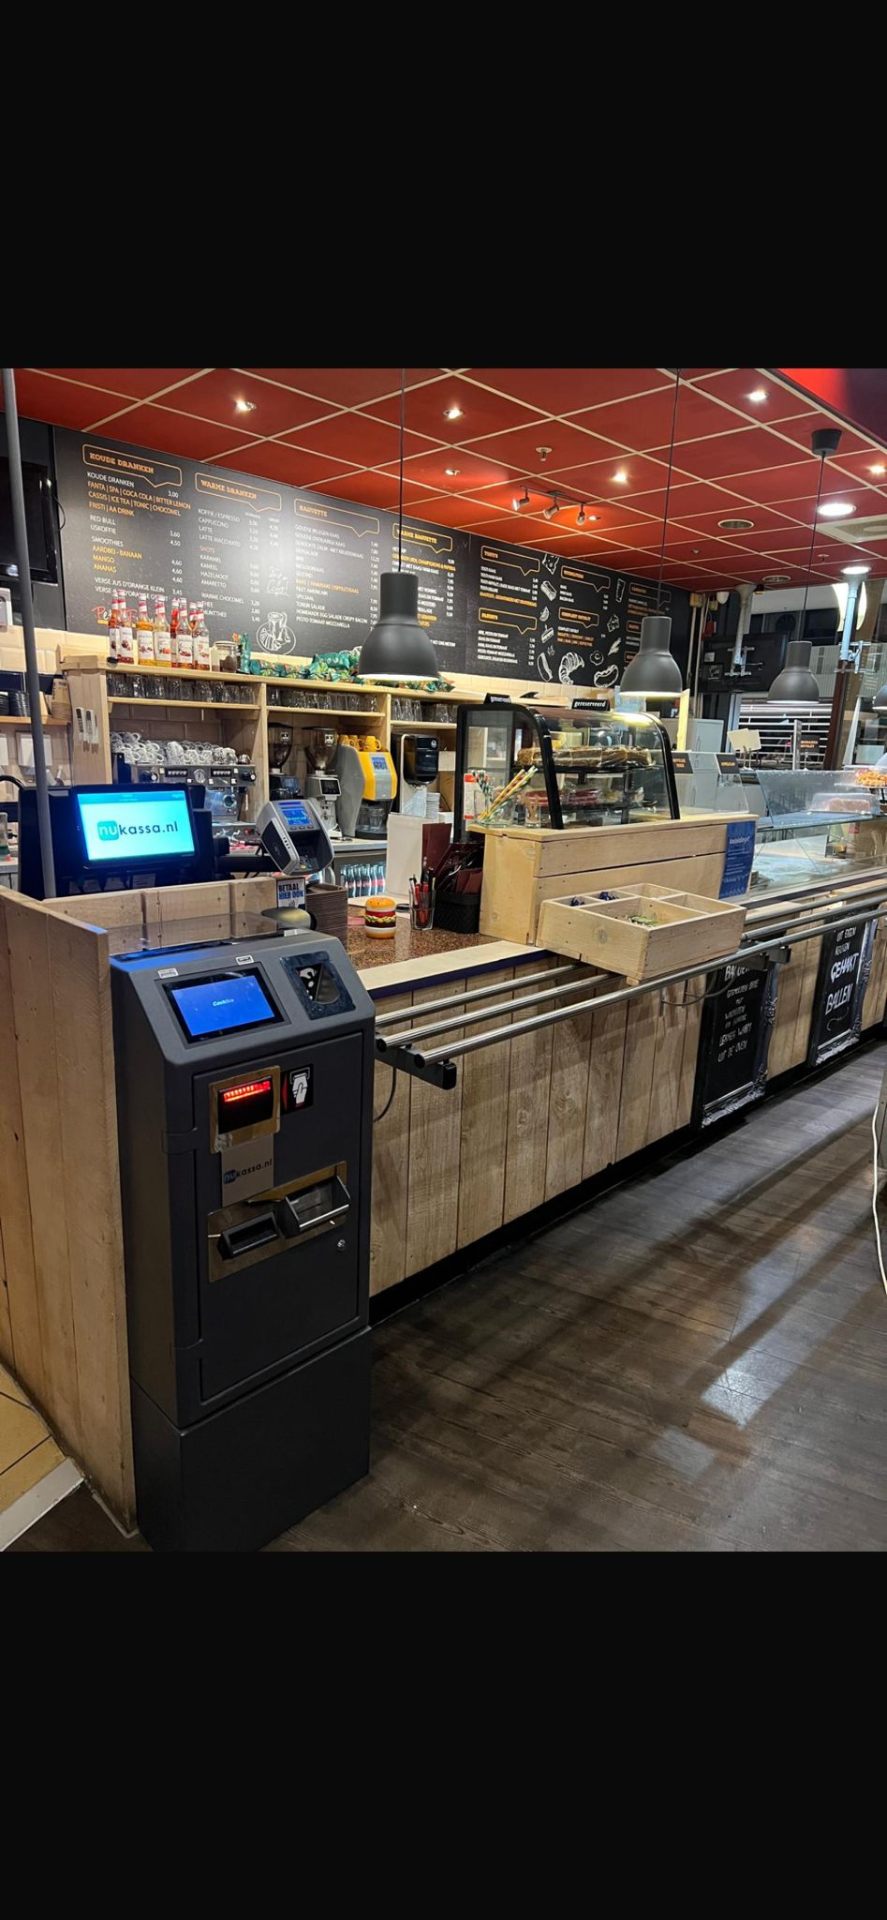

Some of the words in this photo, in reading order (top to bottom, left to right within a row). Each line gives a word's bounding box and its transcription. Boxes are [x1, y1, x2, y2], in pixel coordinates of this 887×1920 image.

[89, 452, 116, 464] KOUDE
[118, 458, 154, 474] DRANKEN
[87, 471, 106, 482] KOUDE
[108, 476, 135, 489] DRANKEN
[88, 481, 106, 491] FANTA
[108, 485, 120, 494] SPA
[122, 488, 138, 498] COCA
[138, 492, 153, 501] COLA
[88, 491, 108, 500] CASSIS
[90, 514, 101, 522] RED
[118, 507, 135, 516] DRINK
[91, 536, 124, 547] SMOOTHIES
[98, 821, 178, 838] nukassa.nl
[830, 953, 859, 983] GEHAKT
[825, 983, 854, 1015] BALLEN
[224, 1160, 272, 1182] nukassa.nl
